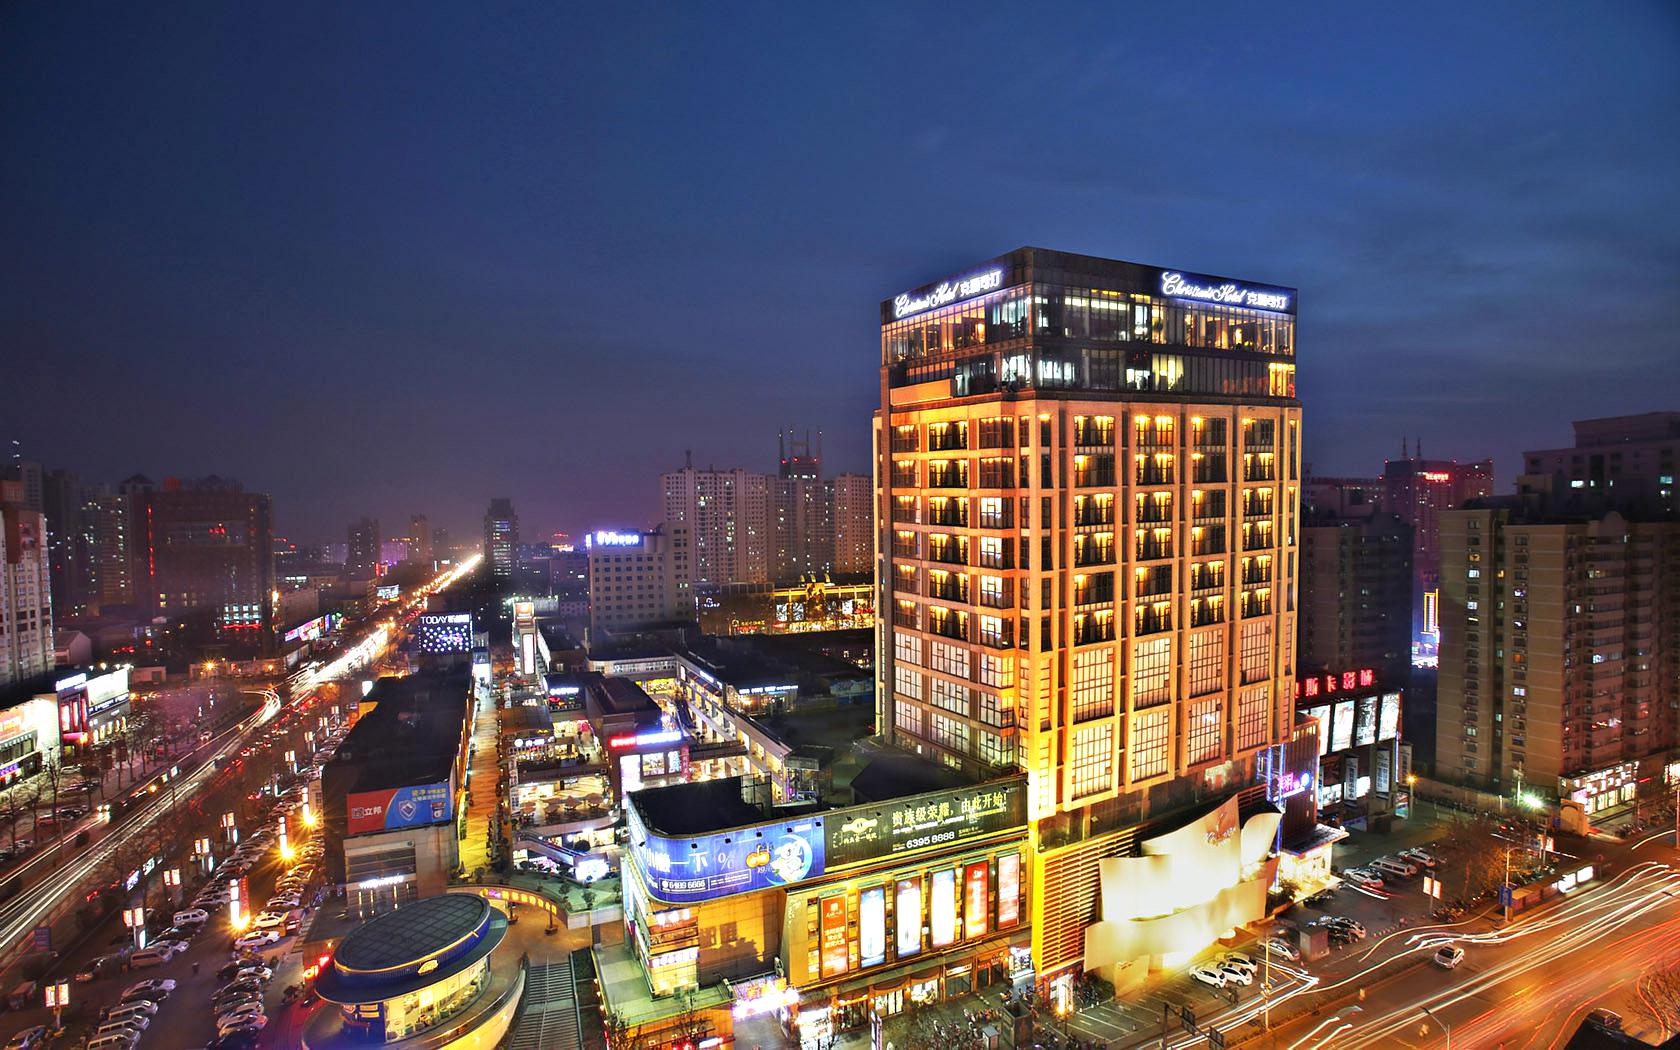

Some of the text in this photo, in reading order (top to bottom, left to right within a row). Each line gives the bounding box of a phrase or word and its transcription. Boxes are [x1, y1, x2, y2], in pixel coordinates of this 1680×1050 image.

[1212, 284, 1248, 303] Hotel
[420, 615, 448, 625] TODAY
[906, 837, 931, 849] 6395
[931, 831, 955, 844] 8888
